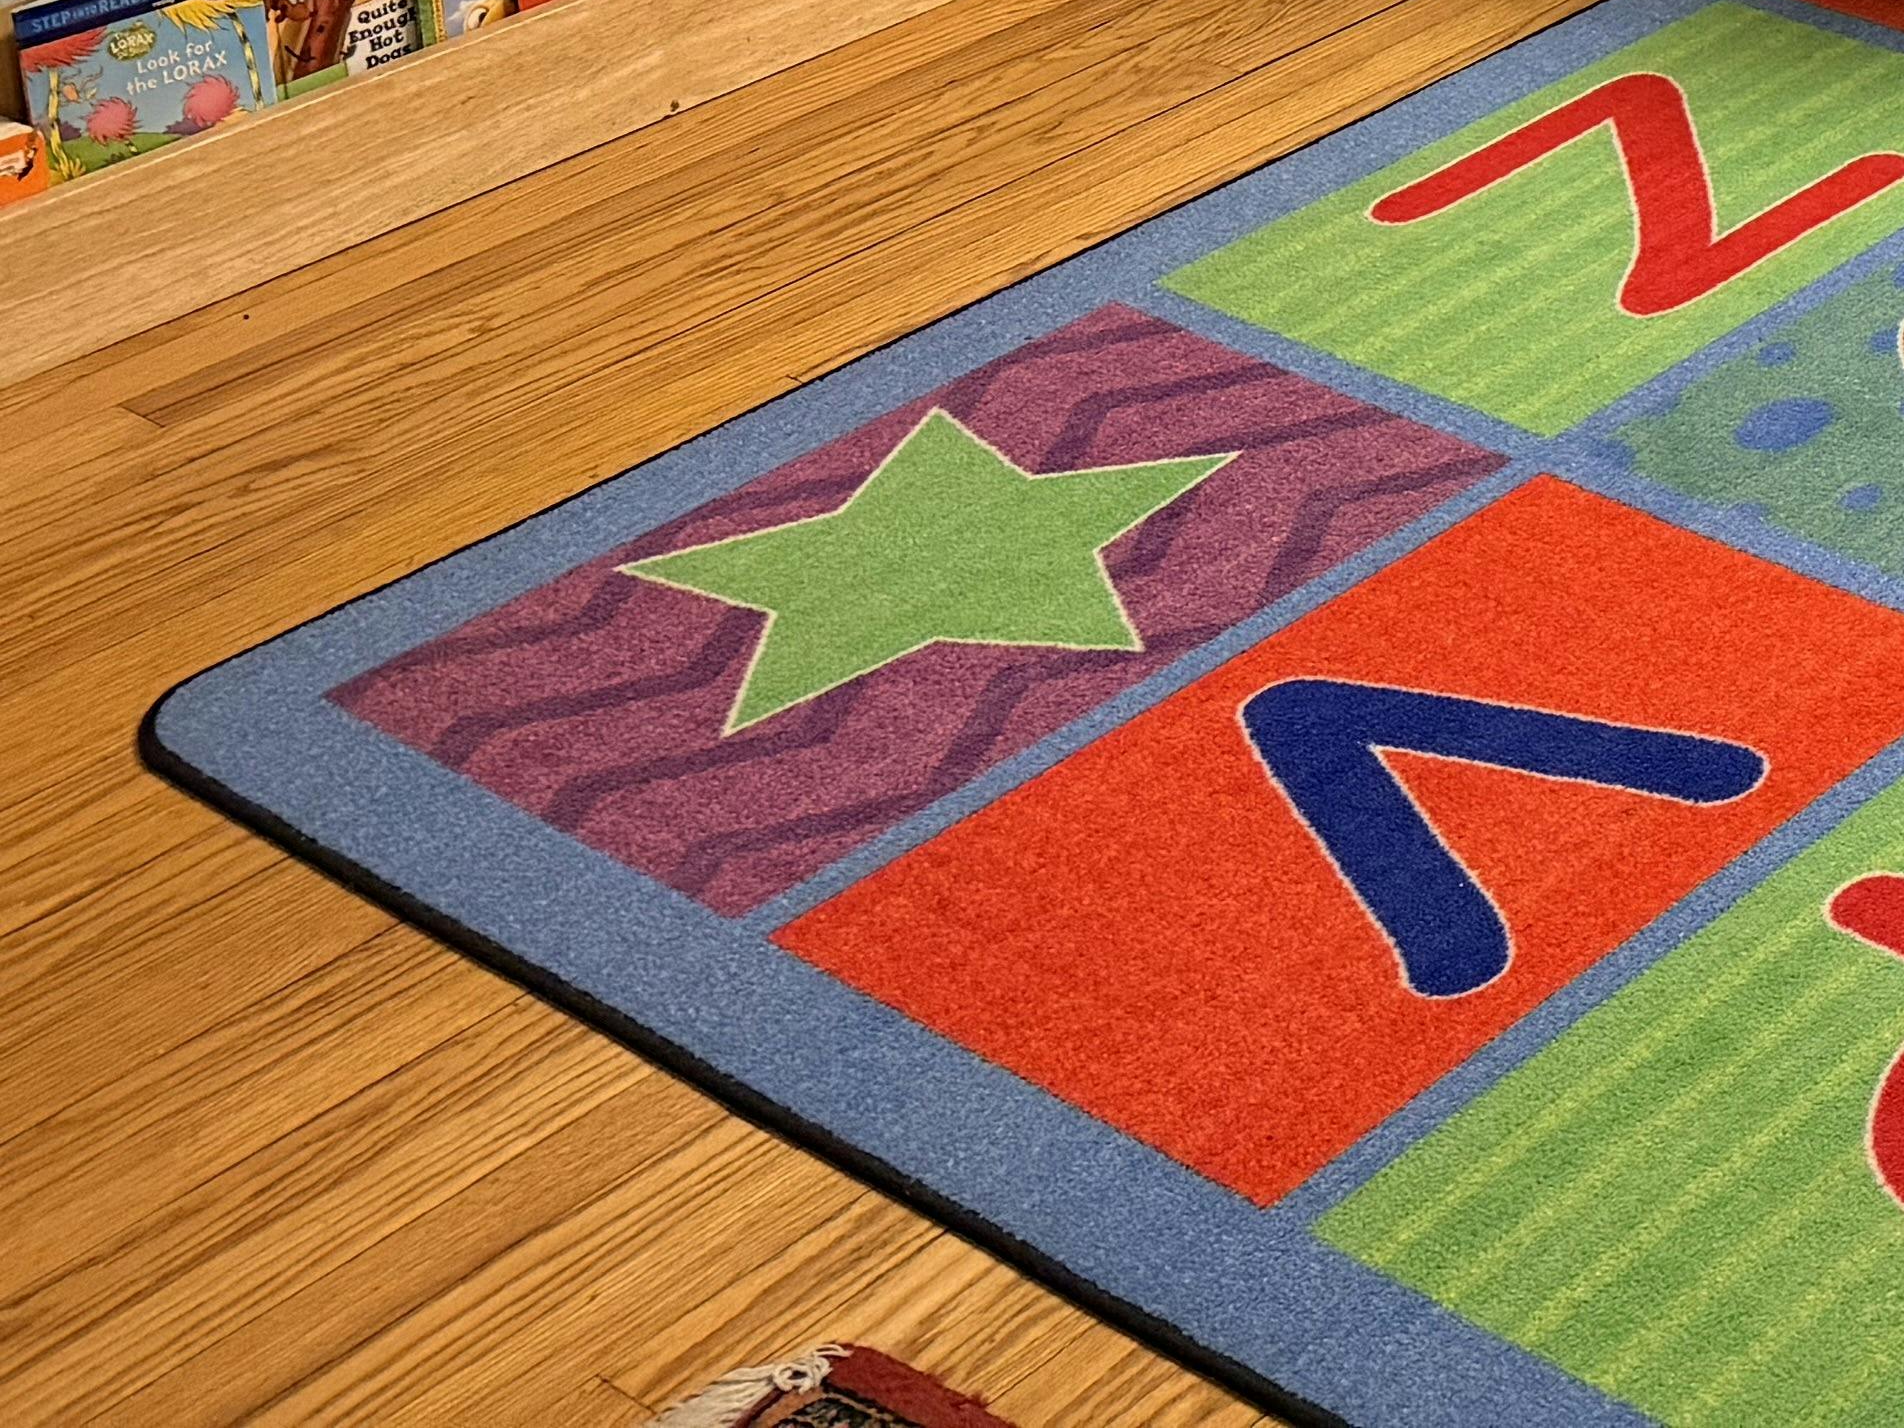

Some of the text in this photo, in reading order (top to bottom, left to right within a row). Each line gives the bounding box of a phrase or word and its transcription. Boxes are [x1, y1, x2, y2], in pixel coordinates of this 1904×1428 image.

[32, 11, 75, 34] STEP
[126, 50, 229, 97] the LORAX
[136, 40, 214, 75] Look for
[1235, 674, 1766, 1001] V
